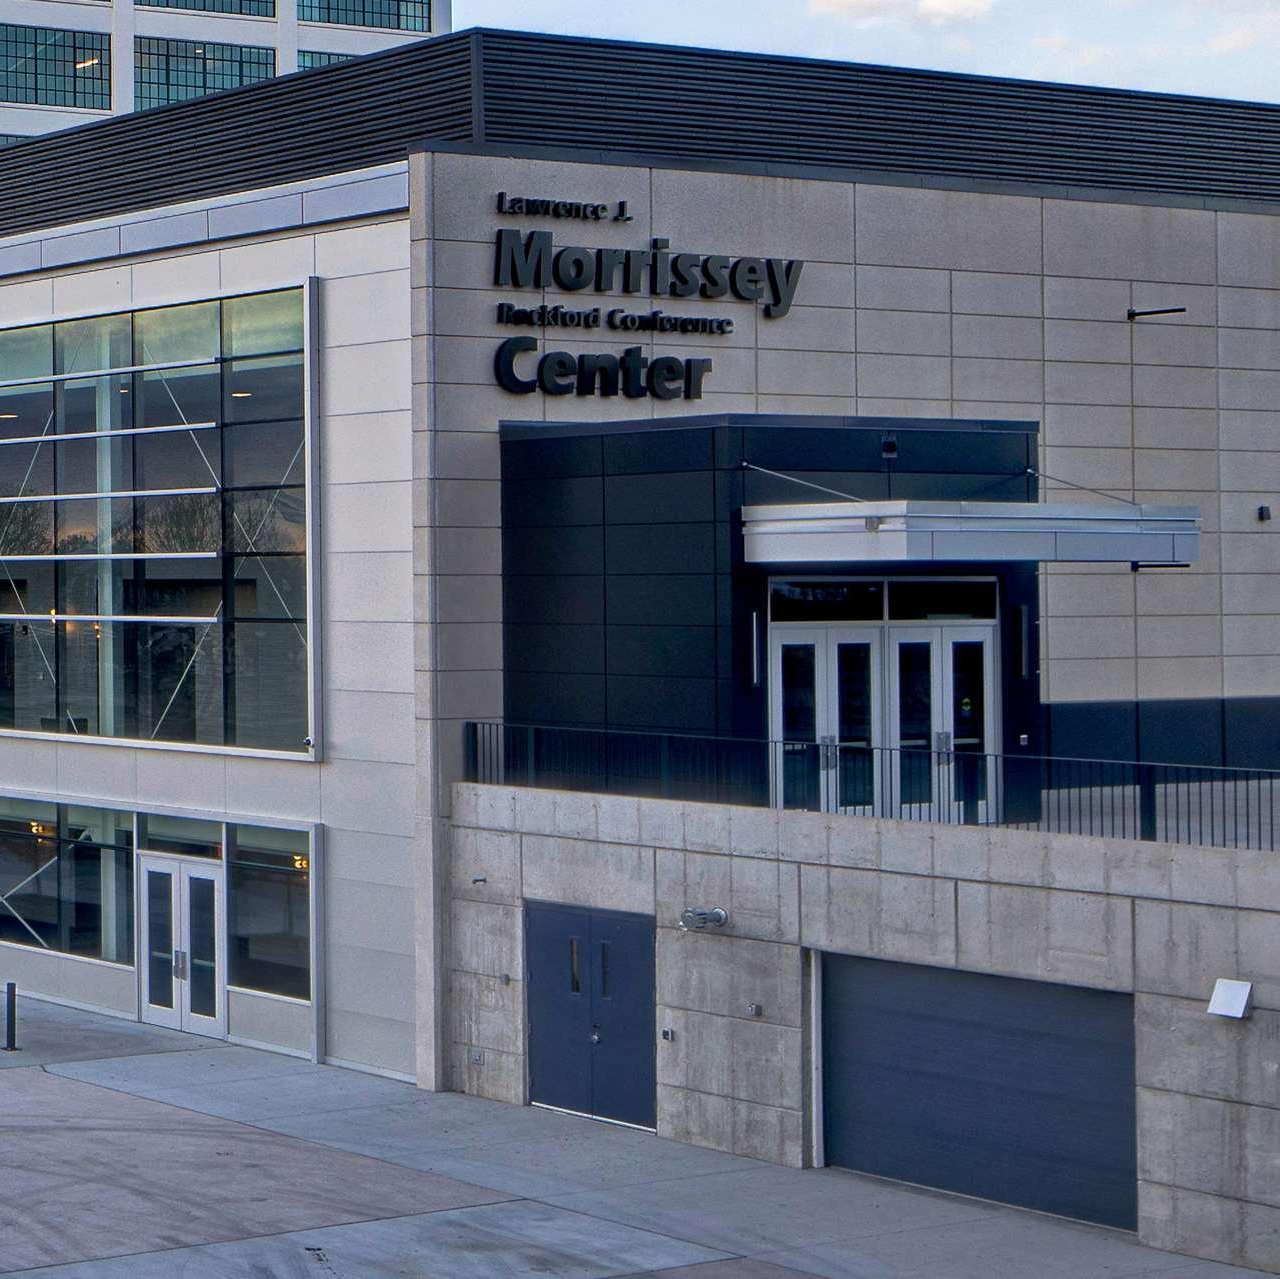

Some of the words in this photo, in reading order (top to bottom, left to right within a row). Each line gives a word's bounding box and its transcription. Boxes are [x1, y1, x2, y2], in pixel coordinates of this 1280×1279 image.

[496, 191, 608, 220] Lawrence
[494, 228, 805, 319] Morrissey
[496, 302, 601, 329] Rockford
[606, 307, 735, 335] Conference
[494, 335, 713, 400] Center
